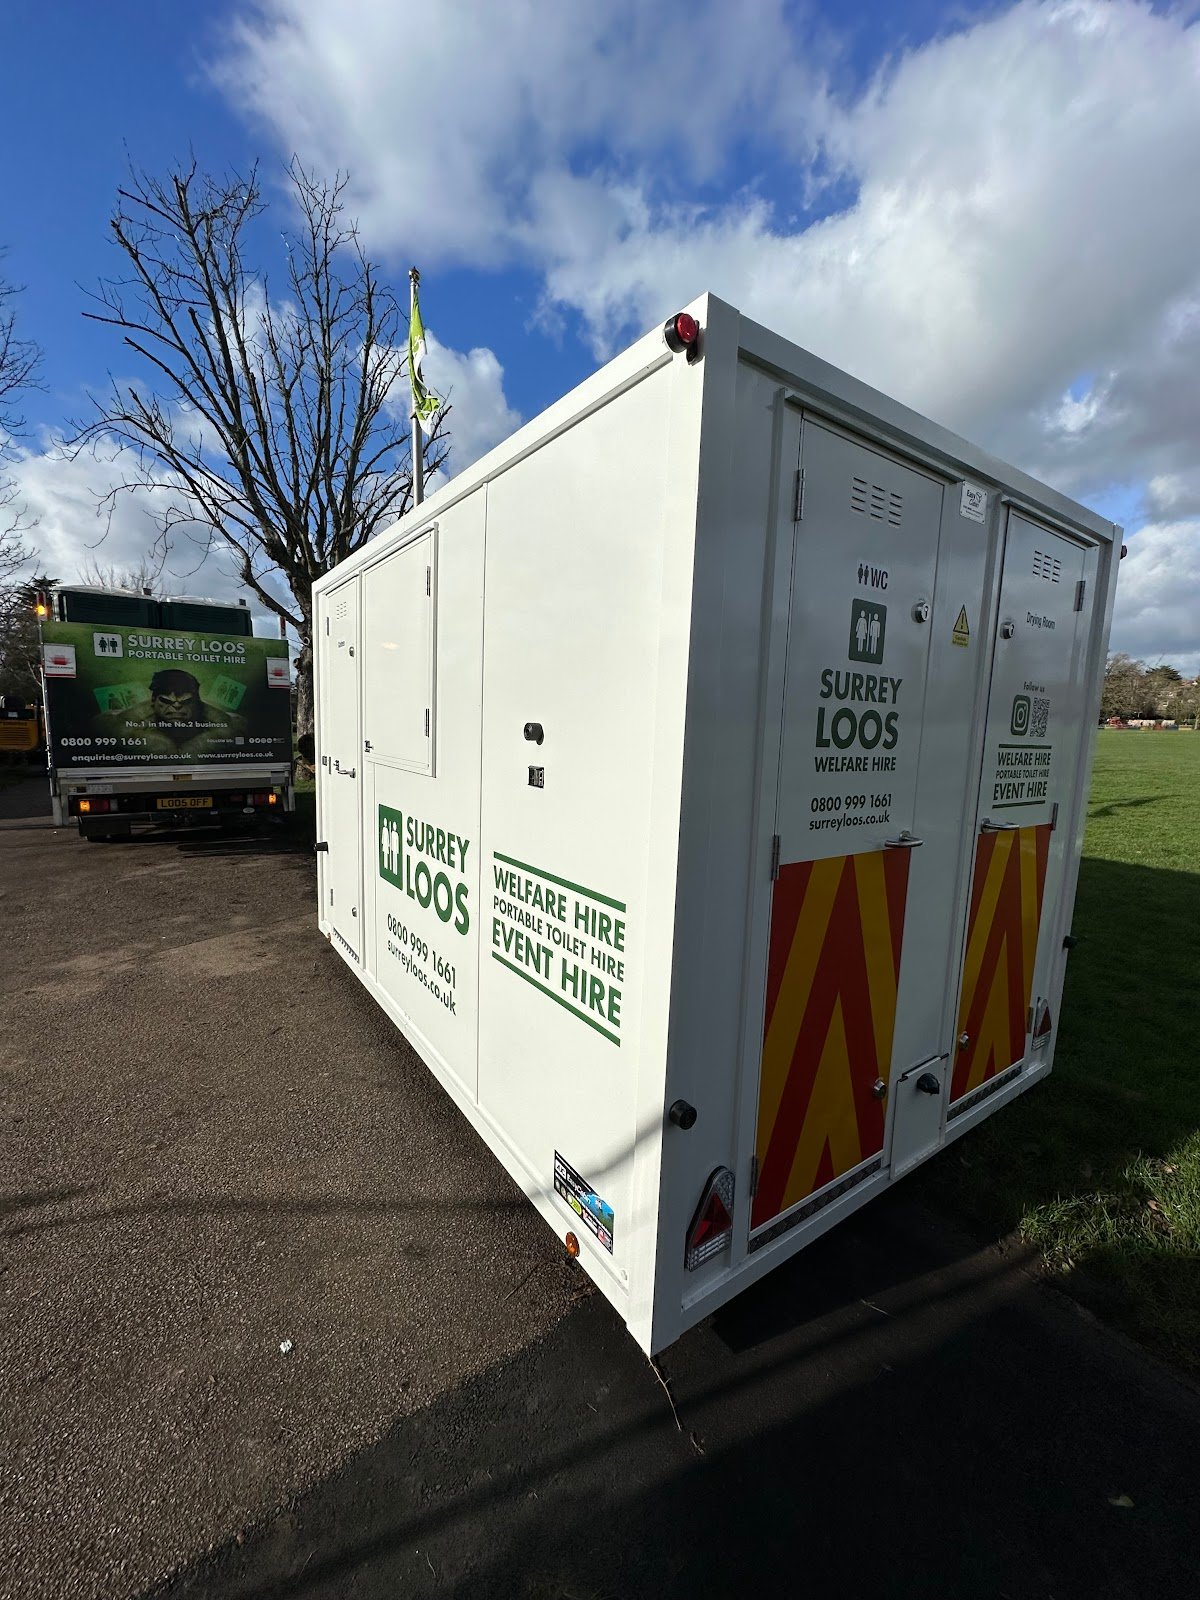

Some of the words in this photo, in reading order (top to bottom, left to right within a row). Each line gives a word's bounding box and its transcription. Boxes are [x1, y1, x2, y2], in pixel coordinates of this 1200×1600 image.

[871, 568, 888, 590] WC
[1026, 612, 1042, 628] Drying
[1042, 616, 1056, 629] Room
[128, 634, 195, 651] SURREY
[202, 640, 246, 654] LOOS
[128, 650, 183, 660] PORTABLE
[187, 653, 220, 662] TOILET
[224, 656, 246, 664] HIRE
[820, 668, 903, 706] SURREY
[1023, 681, 1039, 692] Follow
[815, 706, 900, 750] LOOS
[61, 738, 92, 746] 0800
[95, 738, 117, 746] 999
[121, 737, 147, 746] 1661
[72, 753, 191, 762] enquiries@surreyloos.co.uk
[197, 752, 274, 760] www.surreyloos.co.uk
[814, 755, 869, 773] WELFARE
[871, 756, 897, 772] HIRE
[998, 751, 1033, 766] WELFARE
[1034, 752, 1052, 766] HIRE
[996, 768, 1022, 779] PORTABLE
[1023, 769, 1038, 778] TOILET
[1039, 768, 1050, 778] HIRE
[993, 782, 1026, 801] EVENT
[1027, 781, 1048, 798] HIRE
[810, 794, 842, 813] 0800
[845, 794, 866, 810] 999
[870, 793, 892, 809] 1661
[809, 810, 890, 832] surreyloos.co.uk
[406, 816, 470, 873] SURREY
[406, 854, 469, 936] LOOS
[494, 865, 566, 923] WELFARE
[575, 900, 626, 953] HIRE
[494, 895, 543, 935] PORTABLE
[546, 923, 586, 957] TOILET
[591, 949, 624, 982] HIRE
[387, 913, 408, 945] 0800
[410, 932, 429, 962] 999
[432, 950, 457, 990] 1661
[387, 940, 457, 1016] surreyloos.co.uk
[492, 917, 553, 980] EVENT
[562, 958, 621, 1029] HIRE
